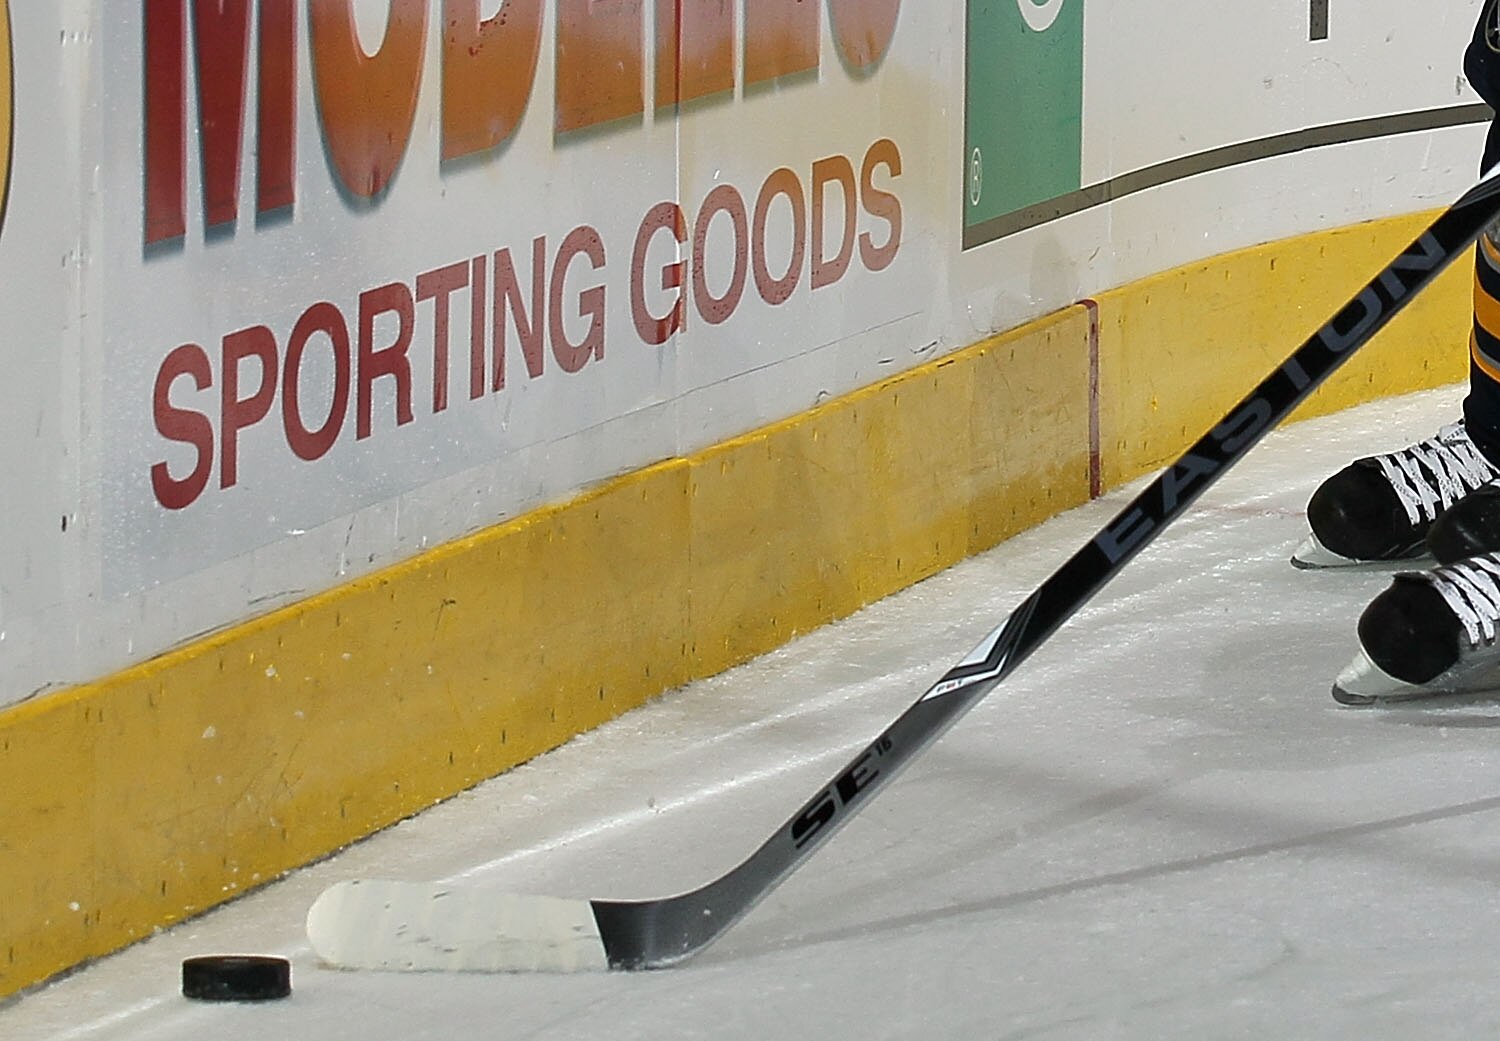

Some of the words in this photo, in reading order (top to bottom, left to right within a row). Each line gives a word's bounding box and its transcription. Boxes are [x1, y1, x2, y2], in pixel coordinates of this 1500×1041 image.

[150, 226, 606, 511] SPORTING
[630, 138, 903, 346] GOODS
[1094, 229, 1448, 565] EASTON
